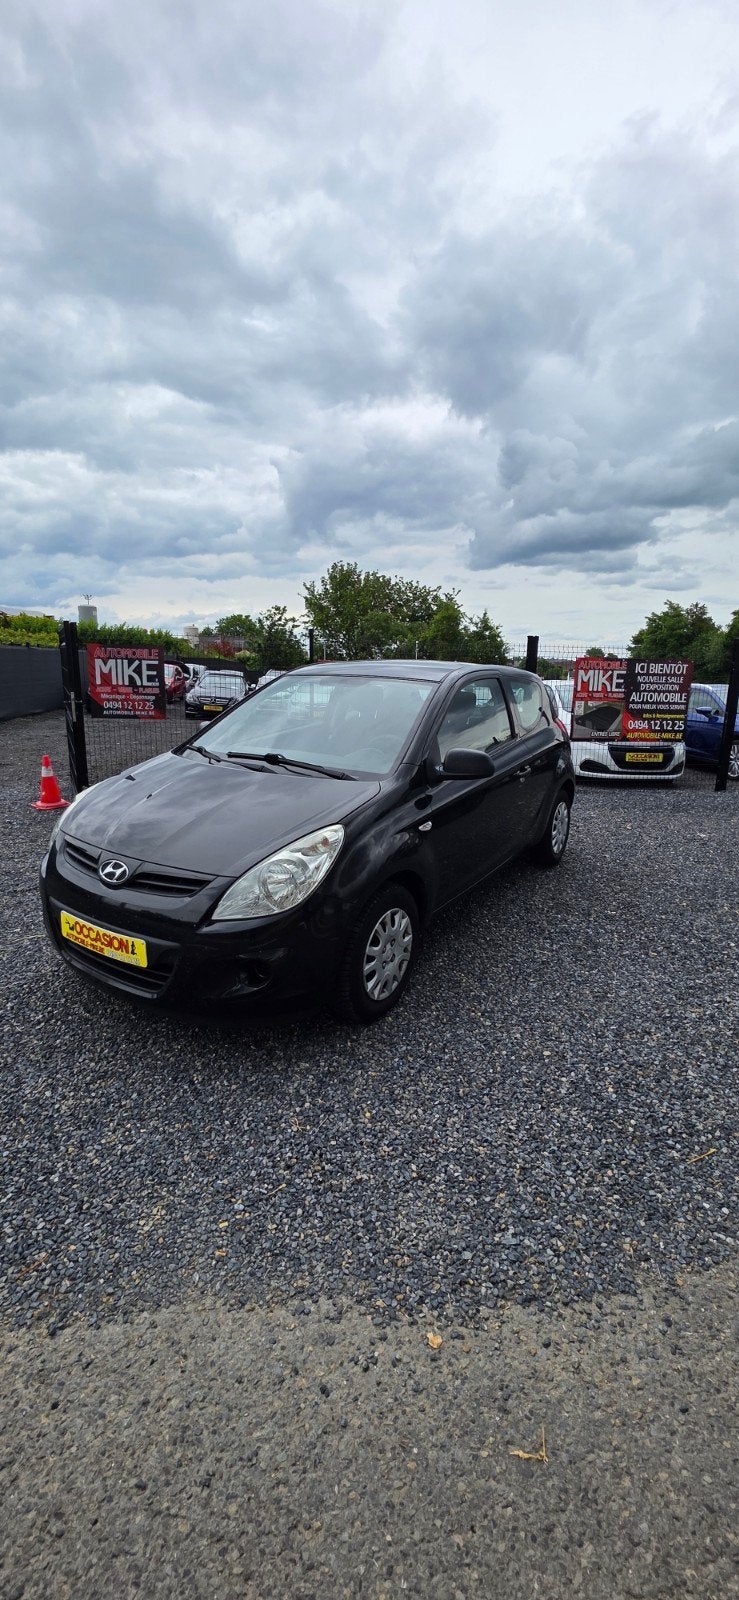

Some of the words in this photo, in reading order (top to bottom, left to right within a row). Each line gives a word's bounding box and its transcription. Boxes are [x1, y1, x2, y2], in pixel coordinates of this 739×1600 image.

[94, 647, 159, 659] AUTOMOBILE
[578, 660, 627, 670] AUTOMOBILE
[635, 663, 647, 673] ICI
[649, 661, 688, 674] BIENTÔT
[94, 658, 159, 686] MIKE
[577, 670, 626, 692] MIKE
[630, 692, 687, 702] AUTOMOBILE
[628, 720, 648, 730] 0494
[650, 720, 660, 730] 12
[663, 720, 672, 730] 12
[674, 720, 684, 730] 25
[74, 921, 129, 954] OCCASION
